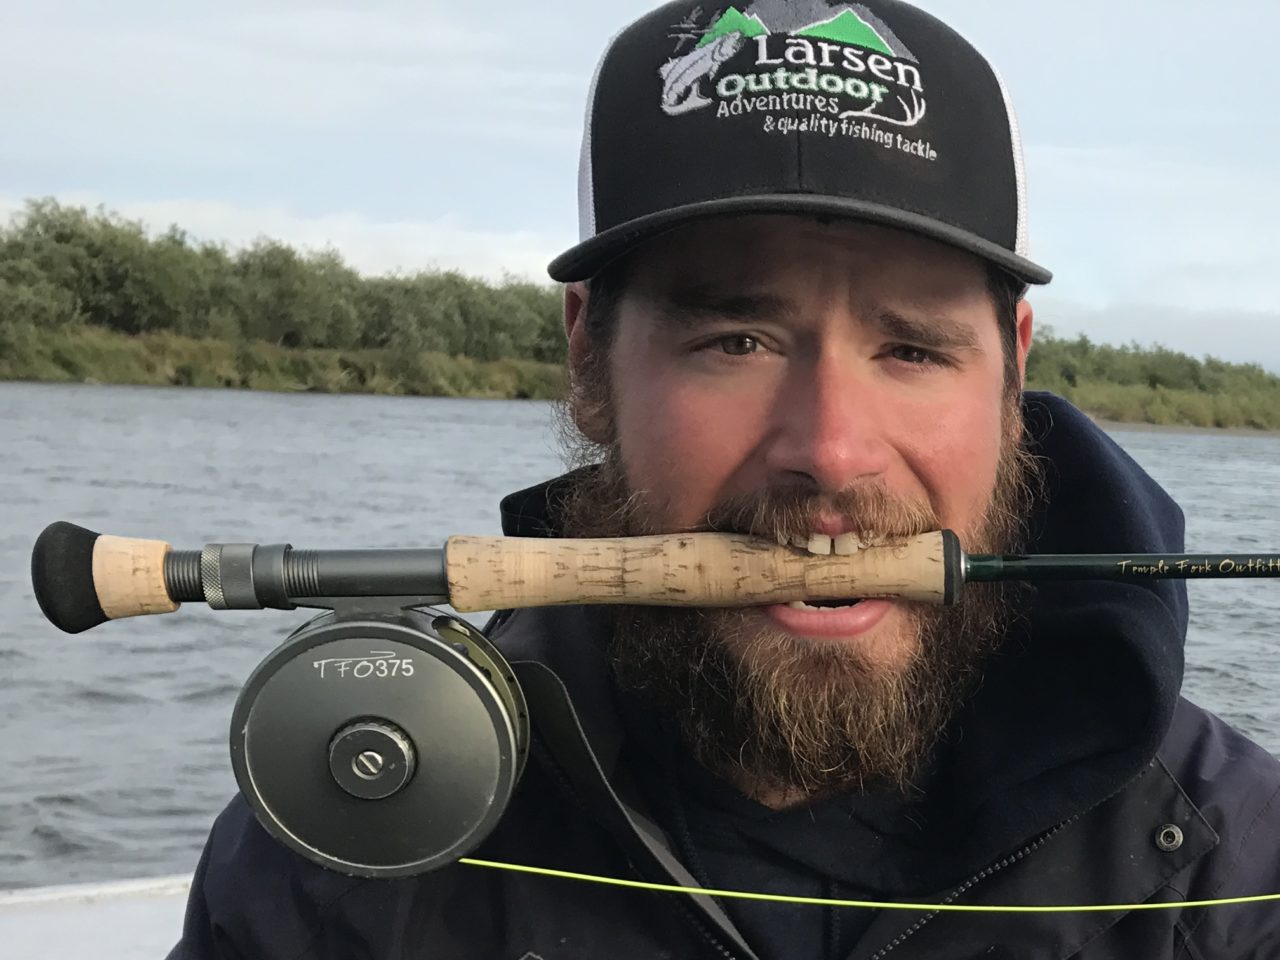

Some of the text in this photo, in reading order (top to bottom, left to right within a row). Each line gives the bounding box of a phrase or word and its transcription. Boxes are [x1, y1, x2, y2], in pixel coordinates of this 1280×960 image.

[753, 34, 924, 92] Larsen
[716, 67, 889, 103] Outdoor
[716, 92, 840, 118] Adventures
[763, 113, 938, 161] & quality fishing tackle
[1117, 559, 1170, 575] Temple
[1175, 559, 1212, 574] Fork
